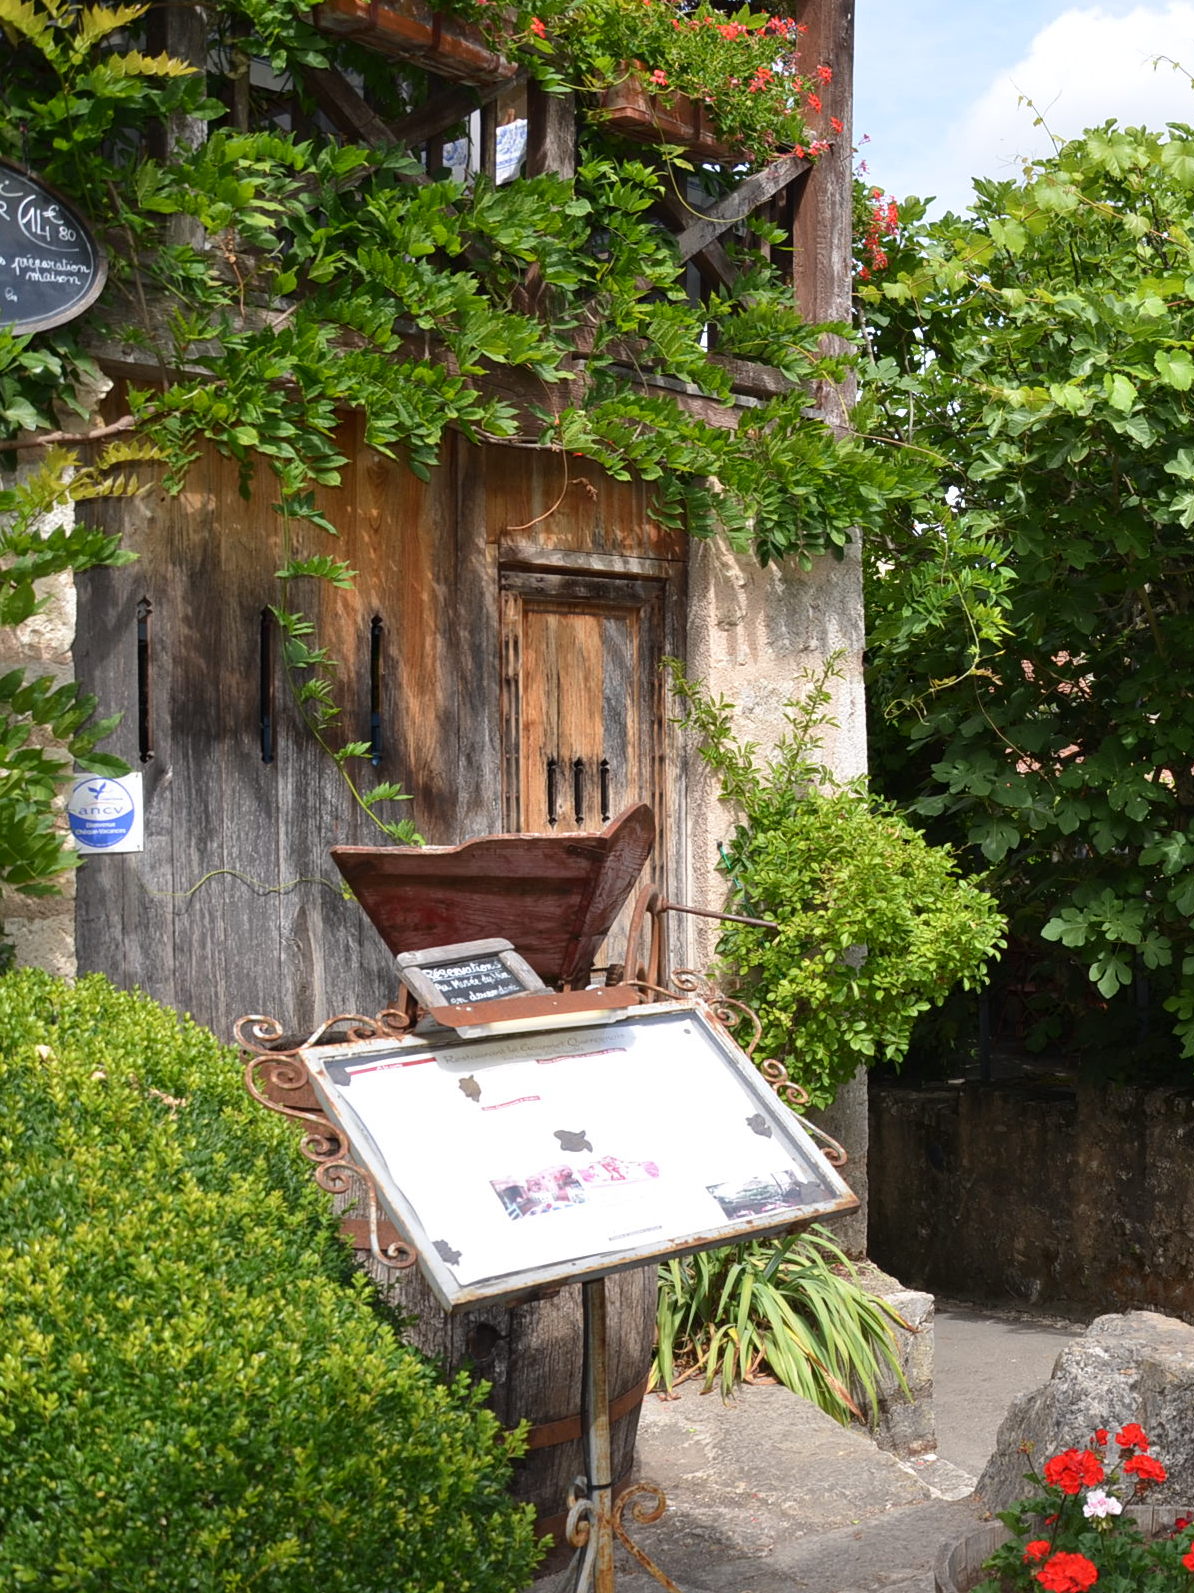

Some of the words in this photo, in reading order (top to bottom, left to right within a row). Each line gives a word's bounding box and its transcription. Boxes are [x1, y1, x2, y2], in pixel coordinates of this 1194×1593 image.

[26, 271, 81, 285] maison
[78, 807, 124, 816] ancv
[421, 961, 502, 981] Réservations
